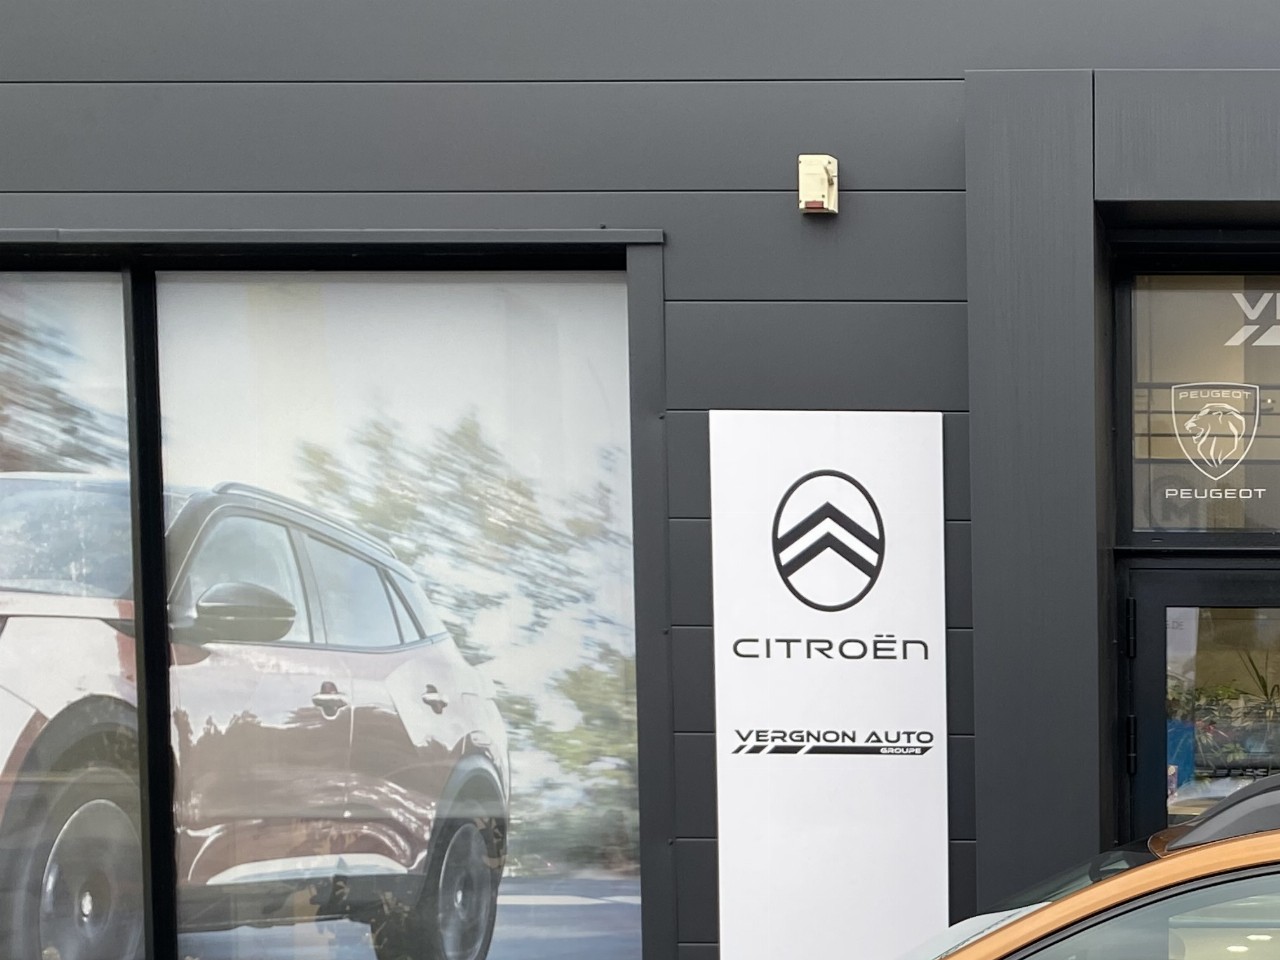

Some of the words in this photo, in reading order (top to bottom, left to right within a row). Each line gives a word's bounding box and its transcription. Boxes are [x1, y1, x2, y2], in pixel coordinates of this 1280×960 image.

[1178, 389, 1252, 400] PEUGEOT
[1165, 487, 1267, 500] PEUGEOT
[734, 729, 857, 744] VERGNON
[863, 730, 935, 745] AUTO
